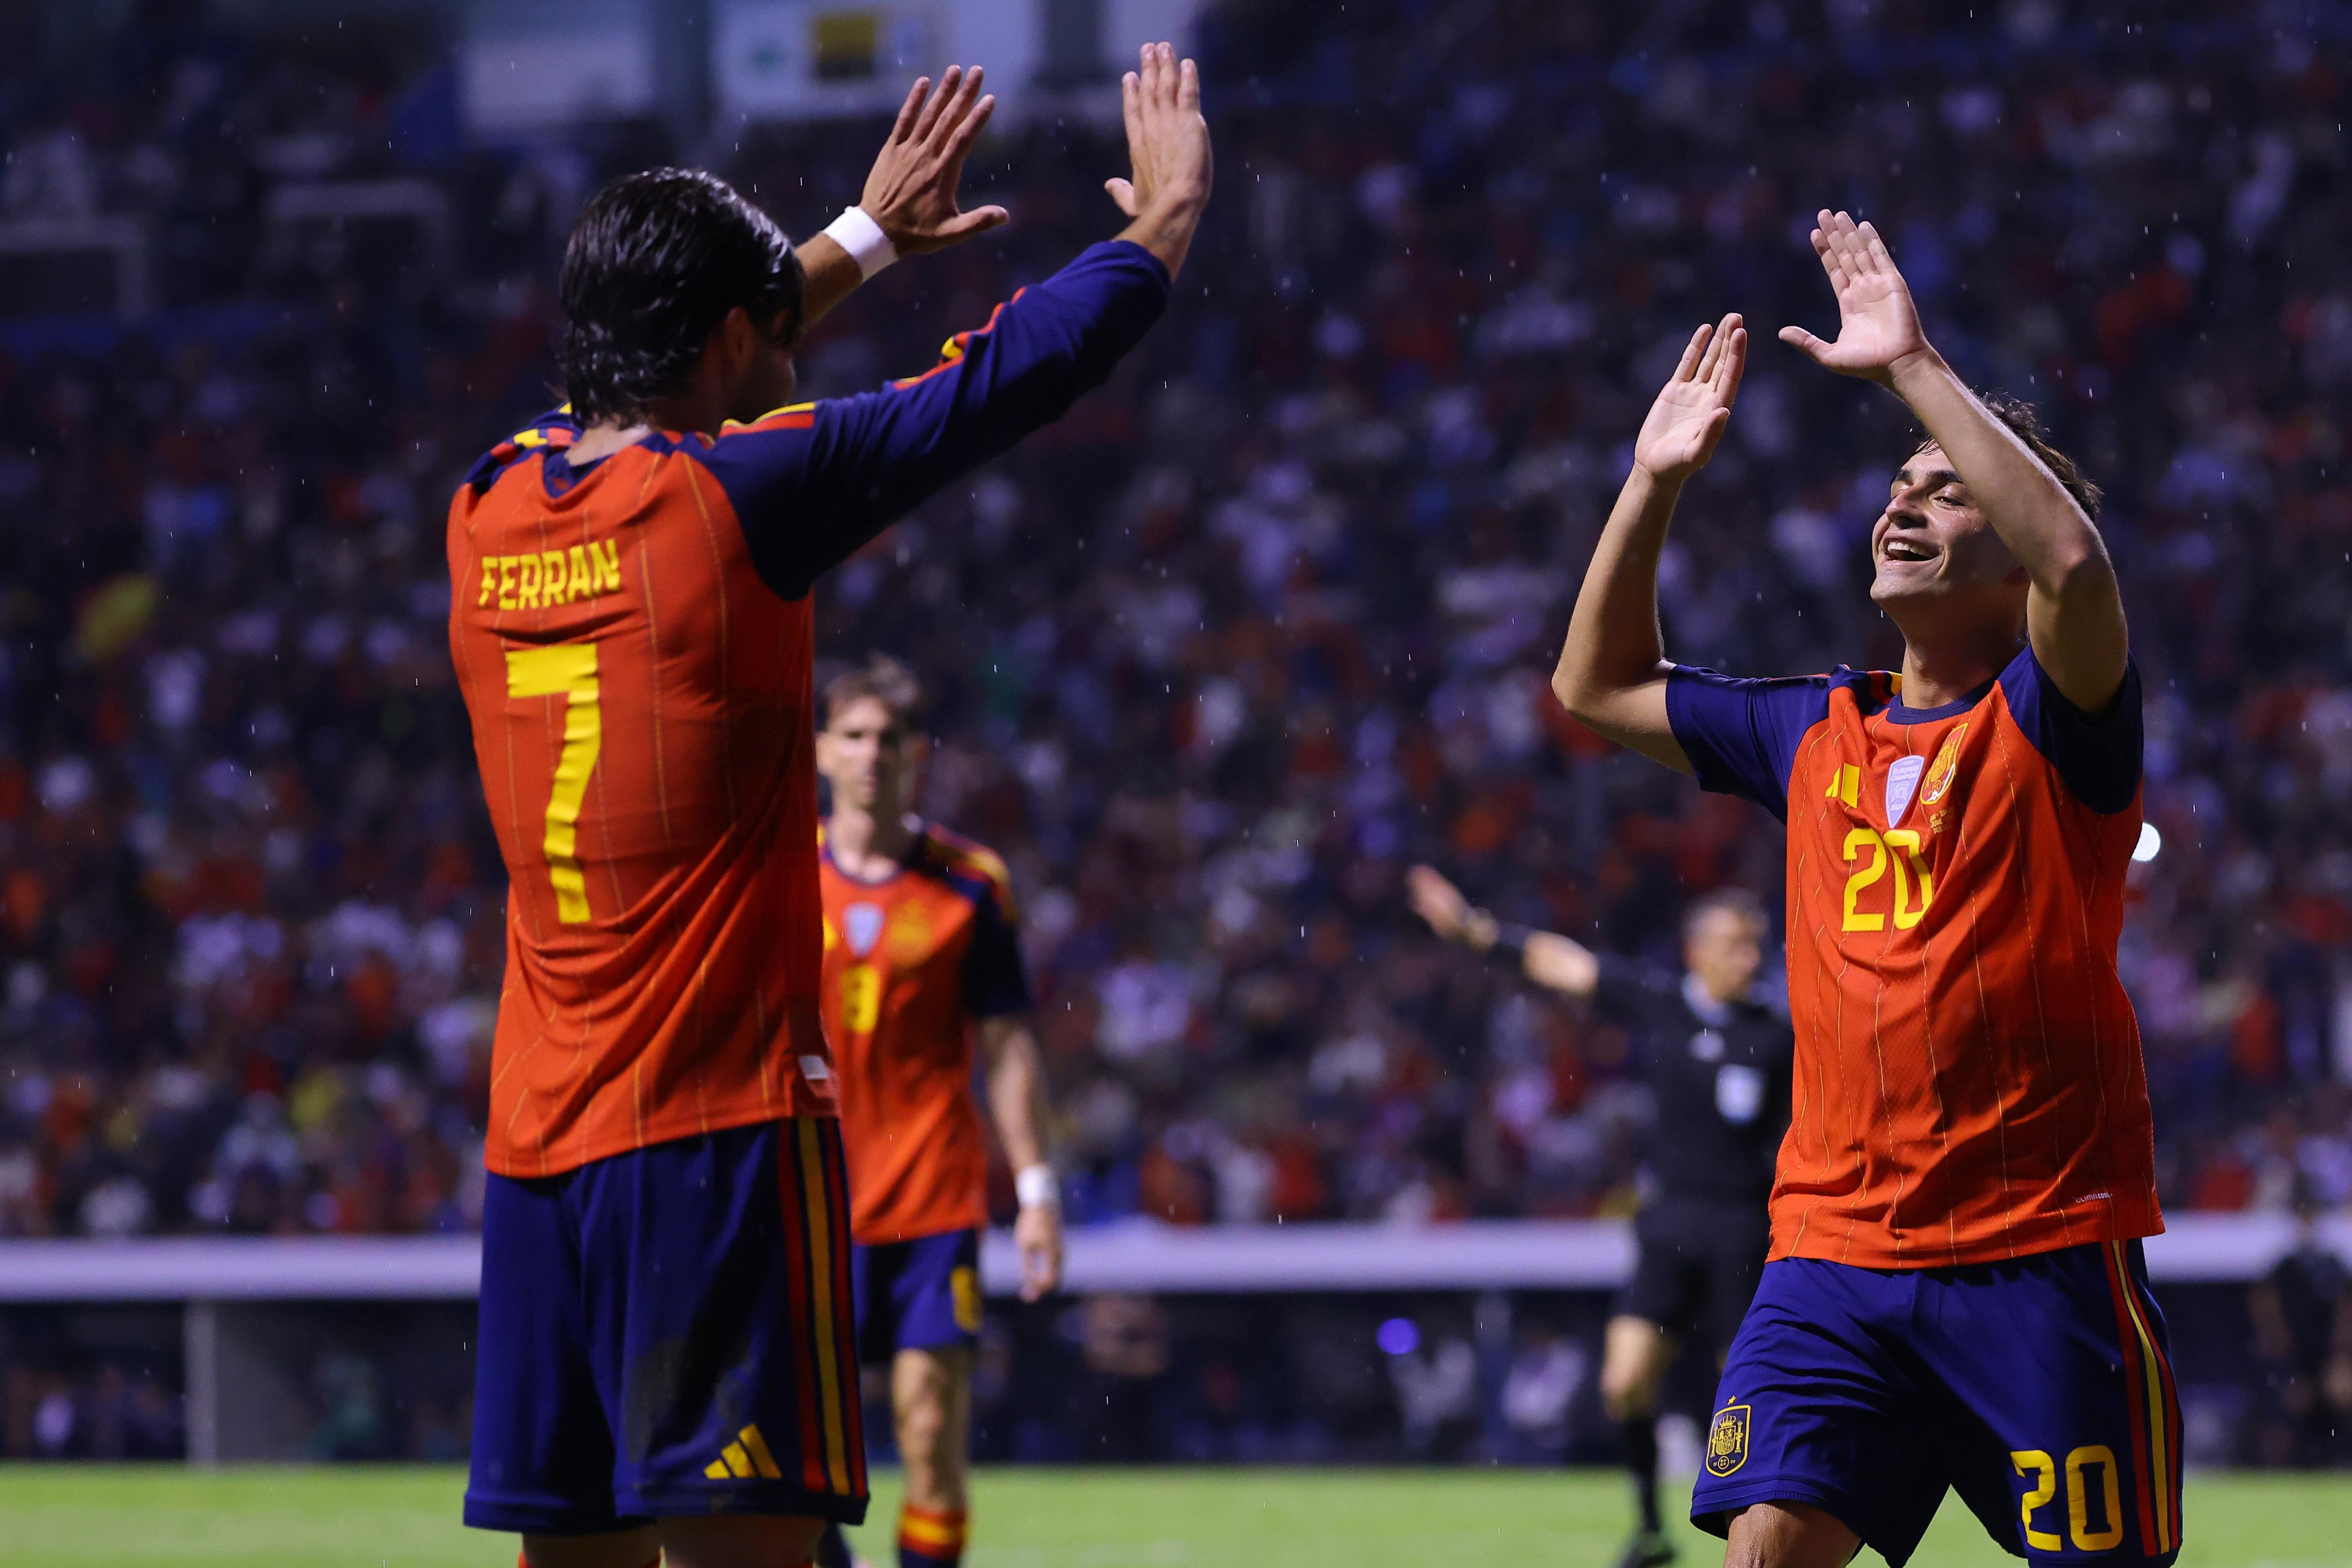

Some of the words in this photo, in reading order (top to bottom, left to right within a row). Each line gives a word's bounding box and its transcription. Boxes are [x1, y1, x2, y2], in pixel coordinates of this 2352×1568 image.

[478, 538, 620, 610] FERRAN
[505, 642, 602, 923] 7
[1890, 802, 1904, 811] 2024
[1841, 828, 1933, 932] 20
[2010, 1444, 2123, 1552] 20
